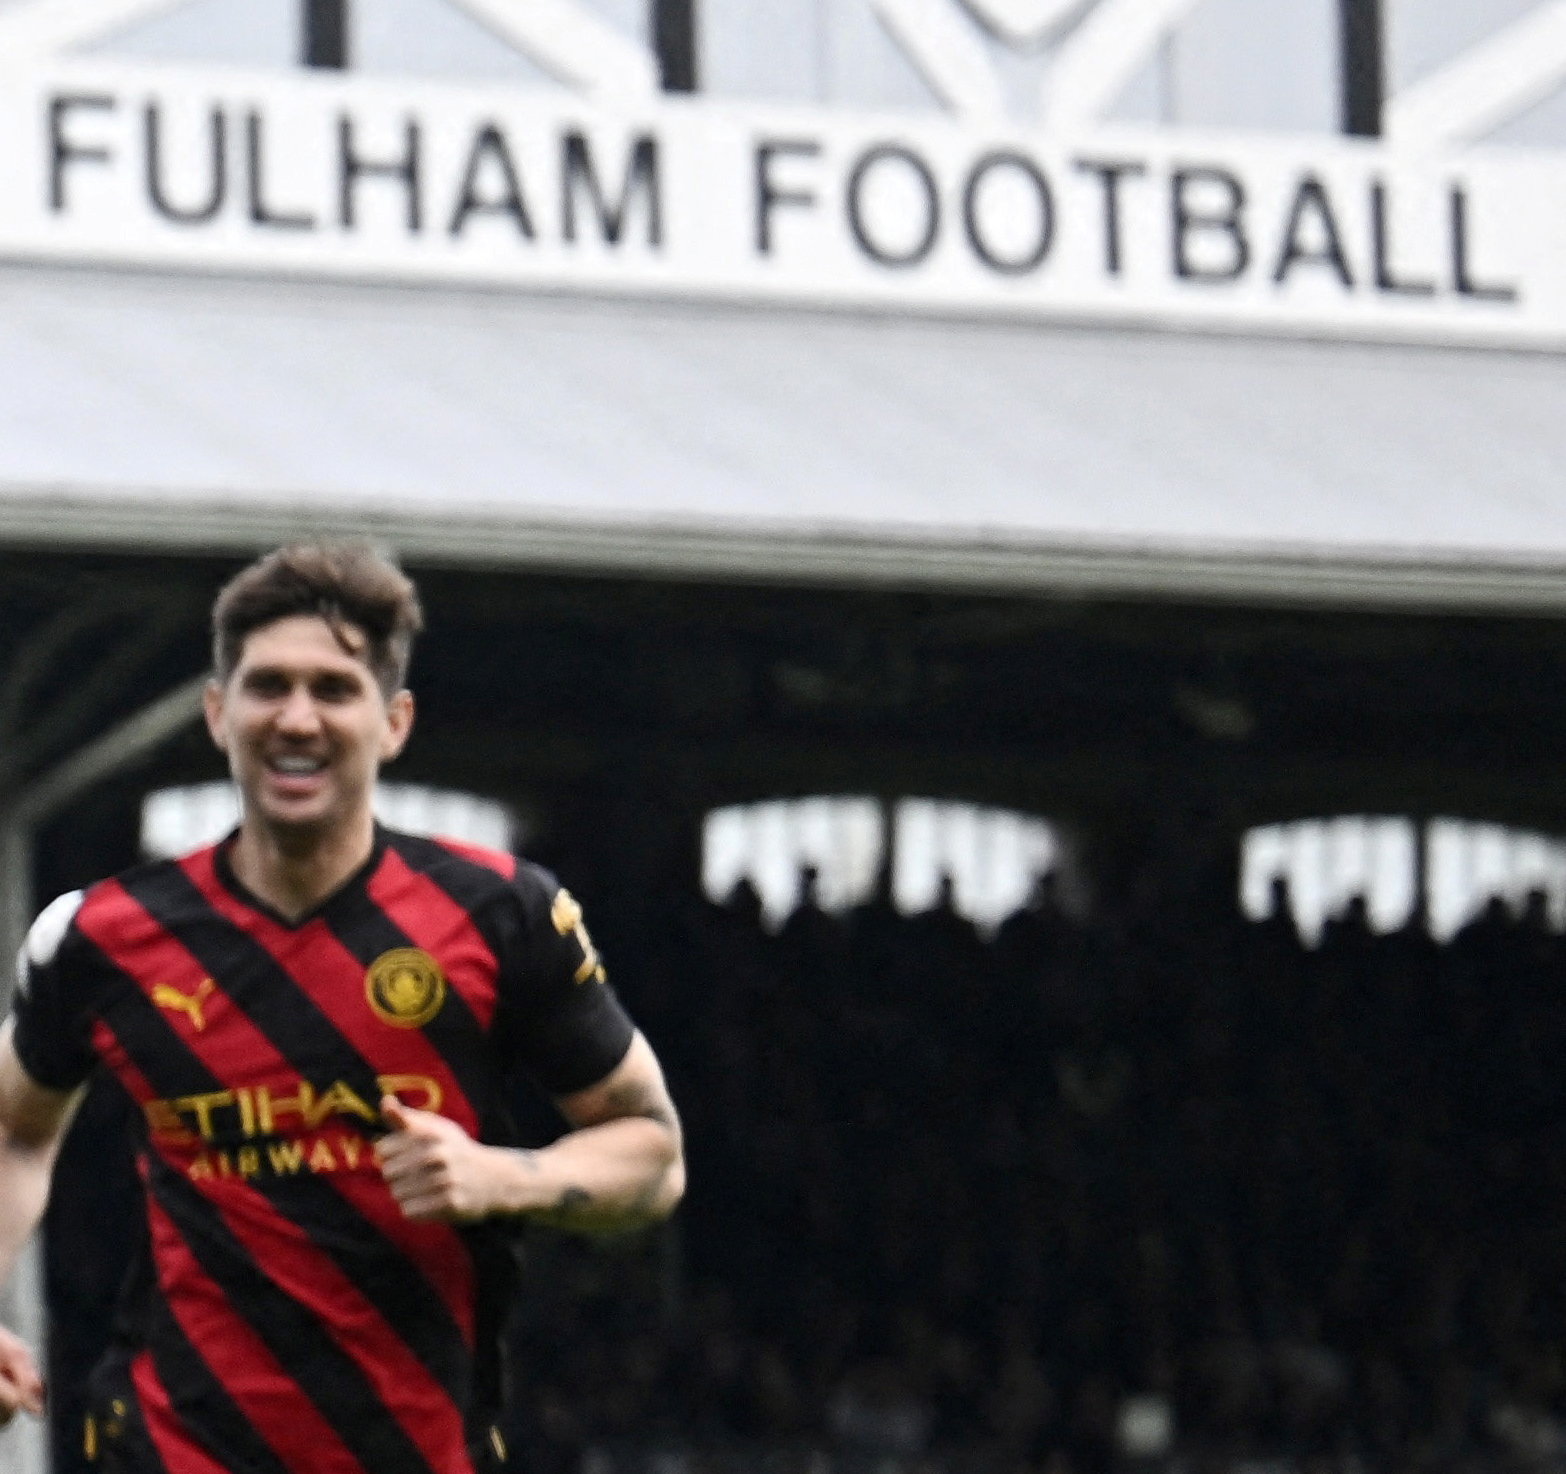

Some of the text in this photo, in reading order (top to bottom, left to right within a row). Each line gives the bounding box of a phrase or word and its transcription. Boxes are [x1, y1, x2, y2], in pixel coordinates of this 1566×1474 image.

[44, 92, 1520, 304] FULHAM FOOTBALL
[186, 1129, 382, 1181] AIRWAY
